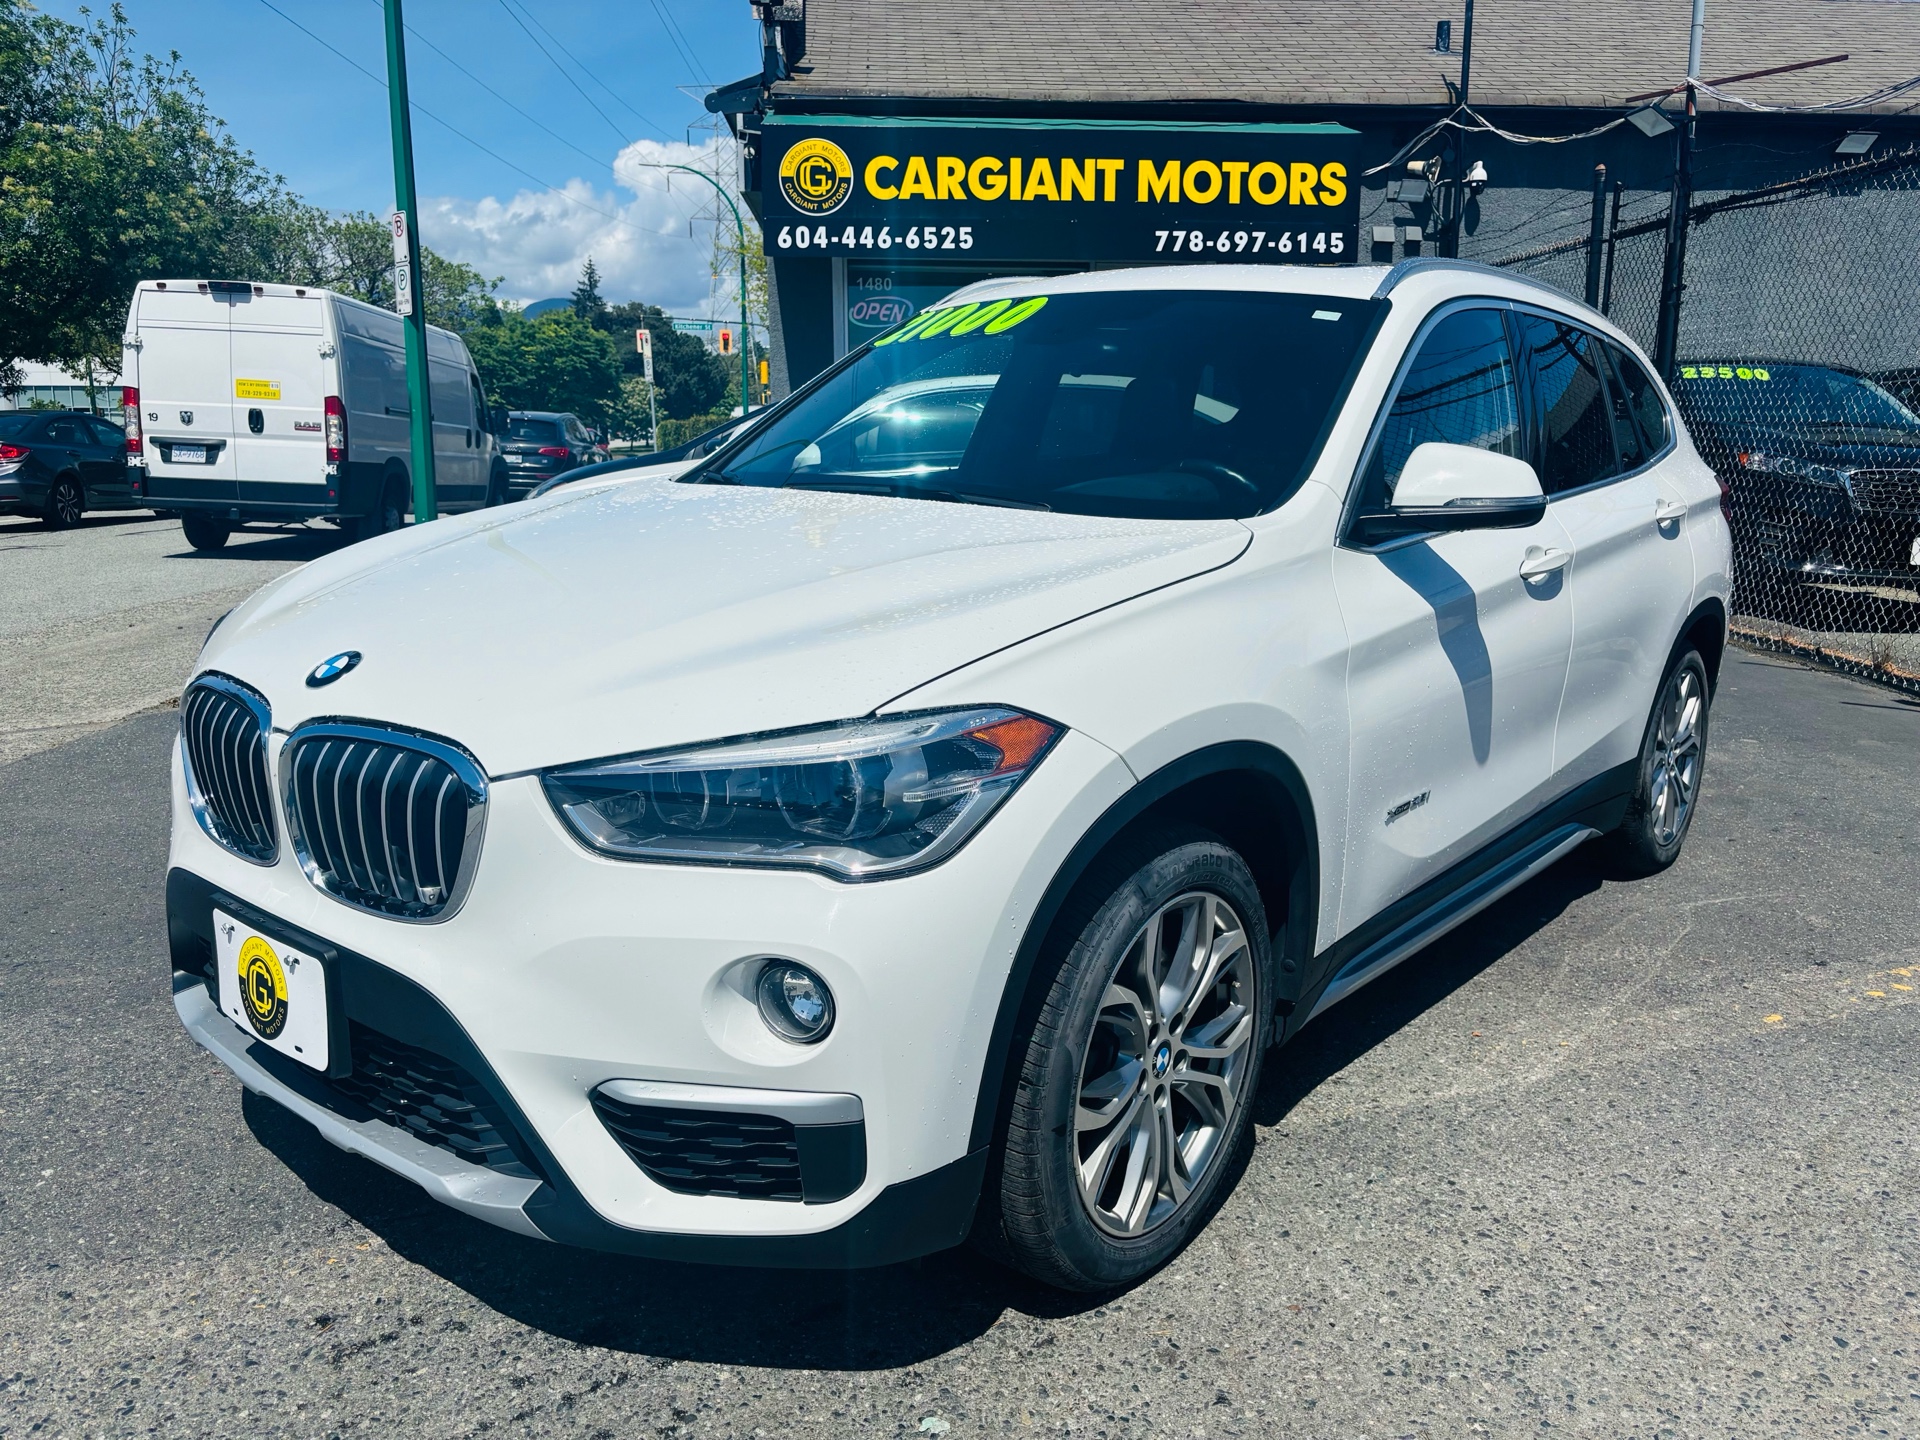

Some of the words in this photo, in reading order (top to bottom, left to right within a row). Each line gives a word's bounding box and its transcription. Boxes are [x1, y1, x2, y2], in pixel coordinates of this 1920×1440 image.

[785, 144, 817, 171] CARGIANT
[821, 145, 847, 173] MOTORS
[864, 155, 1125, 201] CARGIANT
[1137, 159, 1348, 207] MOTORS
[785, 183, 819, 211] CARGIANT
[822, 182, 848, 209] MOTORS
[777, 225, 974, 250] 604-446-6525
[1154, 230, 1345, 254] 778-697-6145
[856, 277, 892, 291] 1480
[853, 302, 906, 323] OPEN
[1681, 366, 1770, 381] 23500
[147, 412, 159, 422] 19
[266, 1006, 285, 1035] MOTORS
